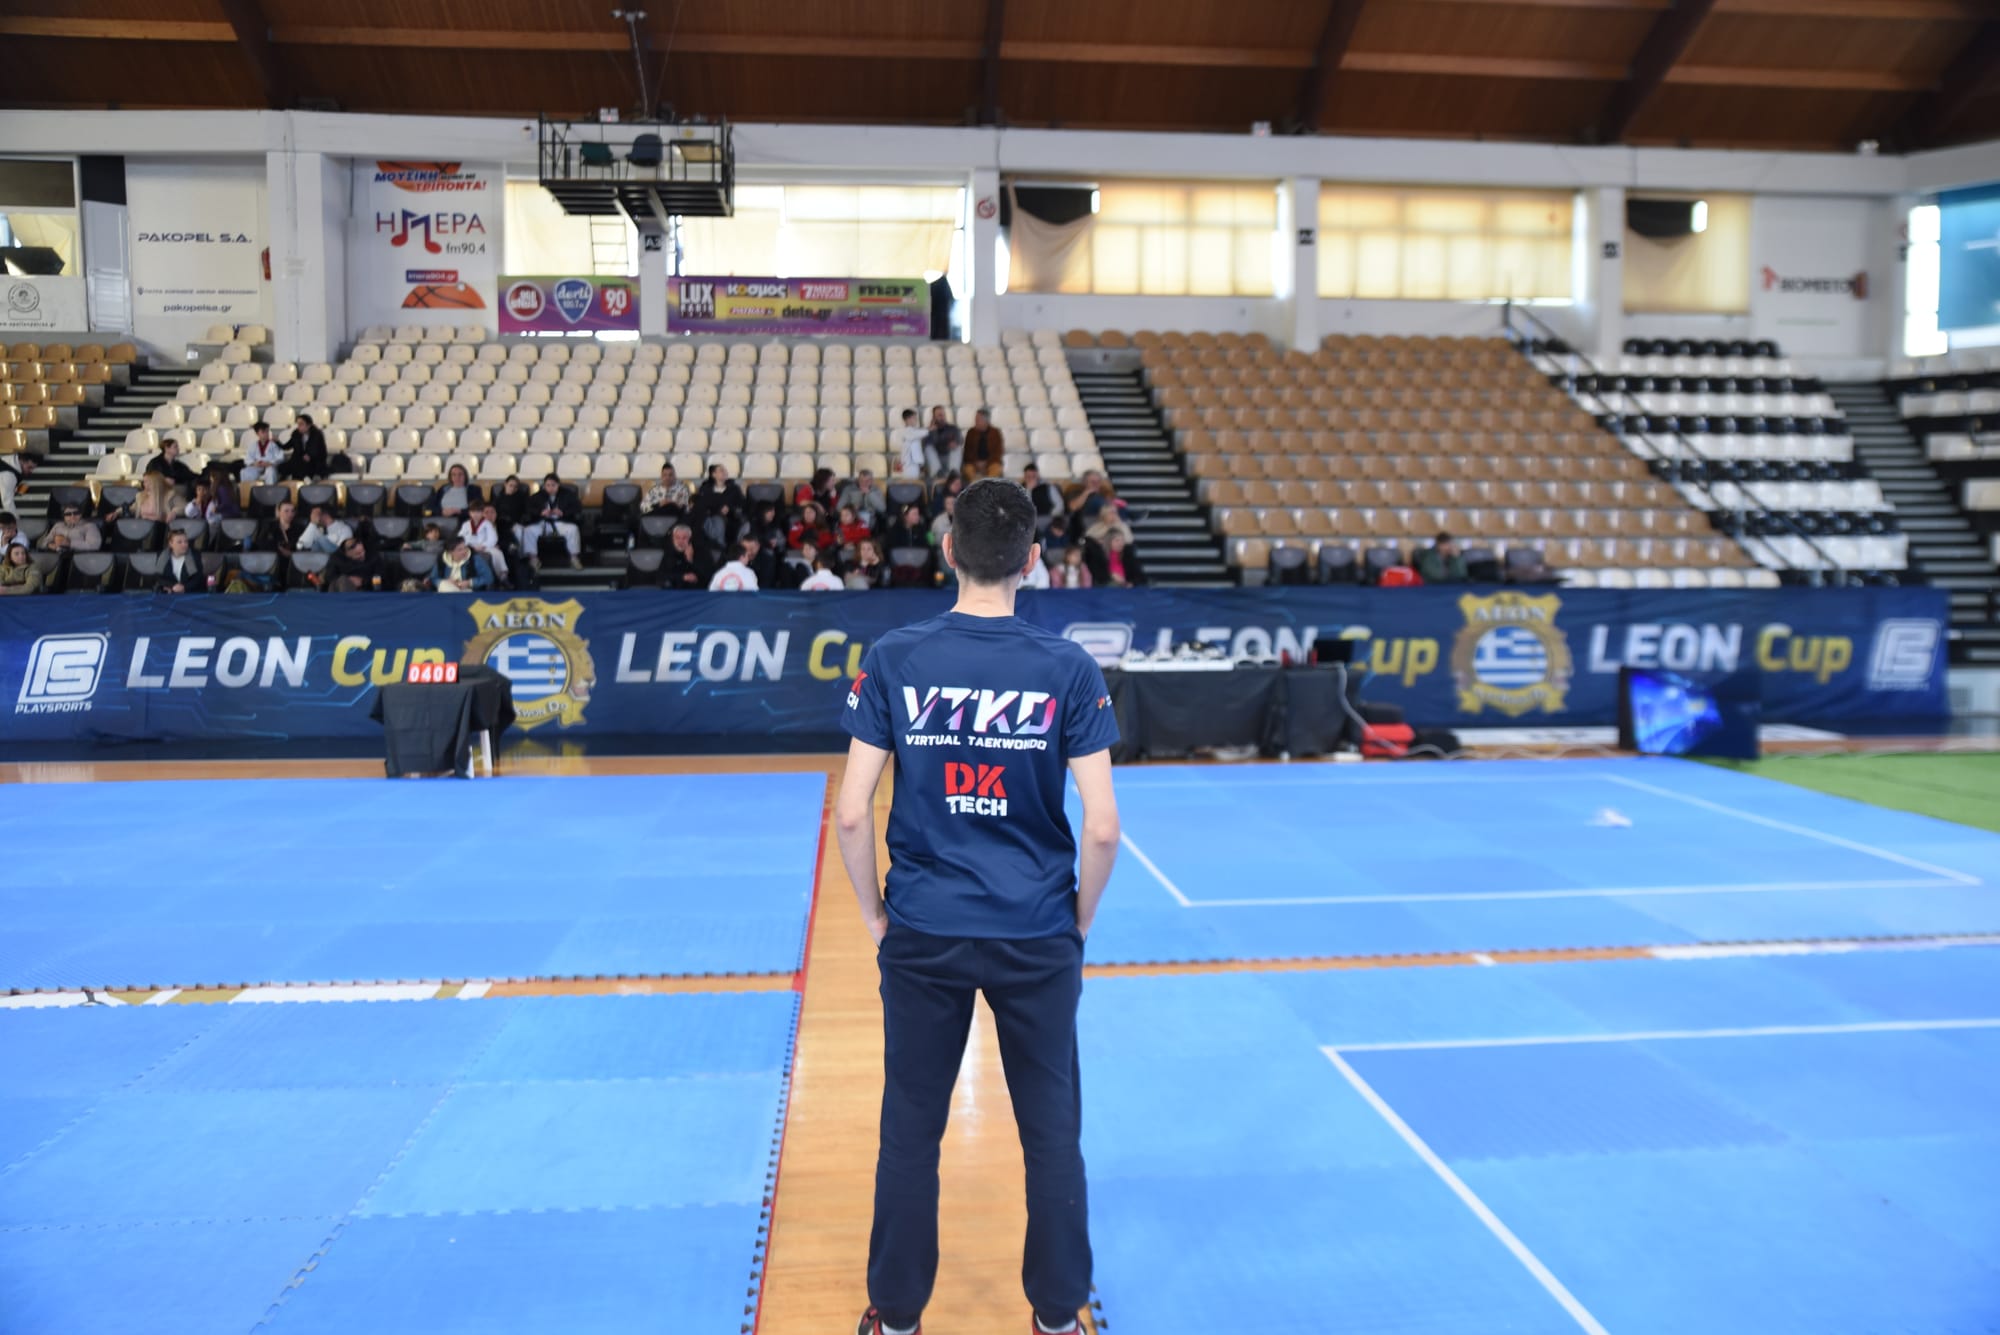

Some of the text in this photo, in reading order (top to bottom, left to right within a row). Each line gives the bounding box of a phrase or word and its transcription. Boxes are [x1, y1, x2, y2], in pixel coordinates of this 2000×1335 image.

[138, 232, 253, 243] PAKOPEL S.A.
[605, 288, 627, 309] 90
[680, 283, 714, 304] LUX
[127, 636, 311, 688] LEON
[616, 631, 790, 682] LEON
[1588, 623, 1854, 684] LEON Cup
[409, 664, 458, 682] 0400
[15, 701, 92, 714] PLAYSPORTS
[903, 686, 1057, 735] VTKD
[905, 735, 1047, 751] VIRTUAL TAEKWONDO
[945, 762, 1007, 798] DK
[946, 796, 1008, 816] TECH
